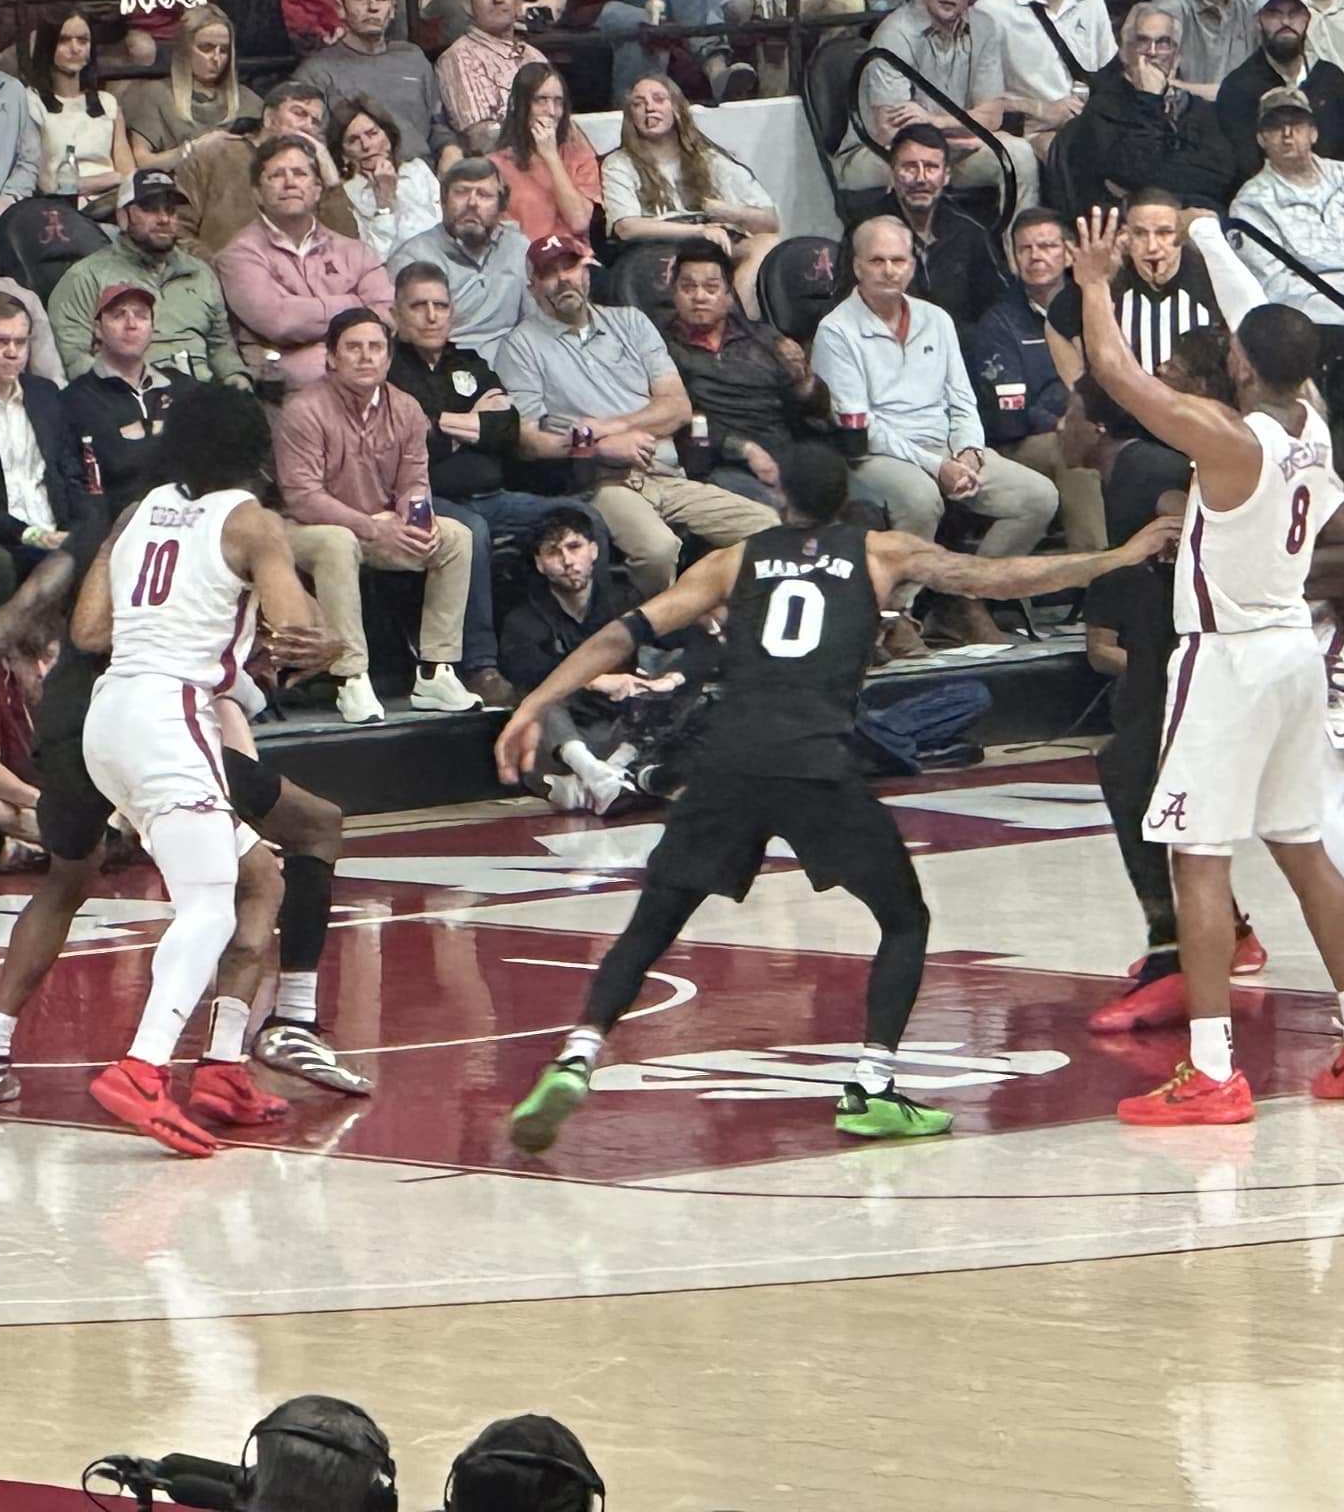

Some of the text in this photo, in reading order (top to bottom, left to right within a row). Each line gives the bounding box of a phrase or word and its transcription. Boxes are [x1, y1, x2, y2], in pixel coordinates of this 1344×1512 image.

[1285, 484, 1312, 557] 8
[131, 538, 179, 608] 10
[760, 579, 826, 659] 0
